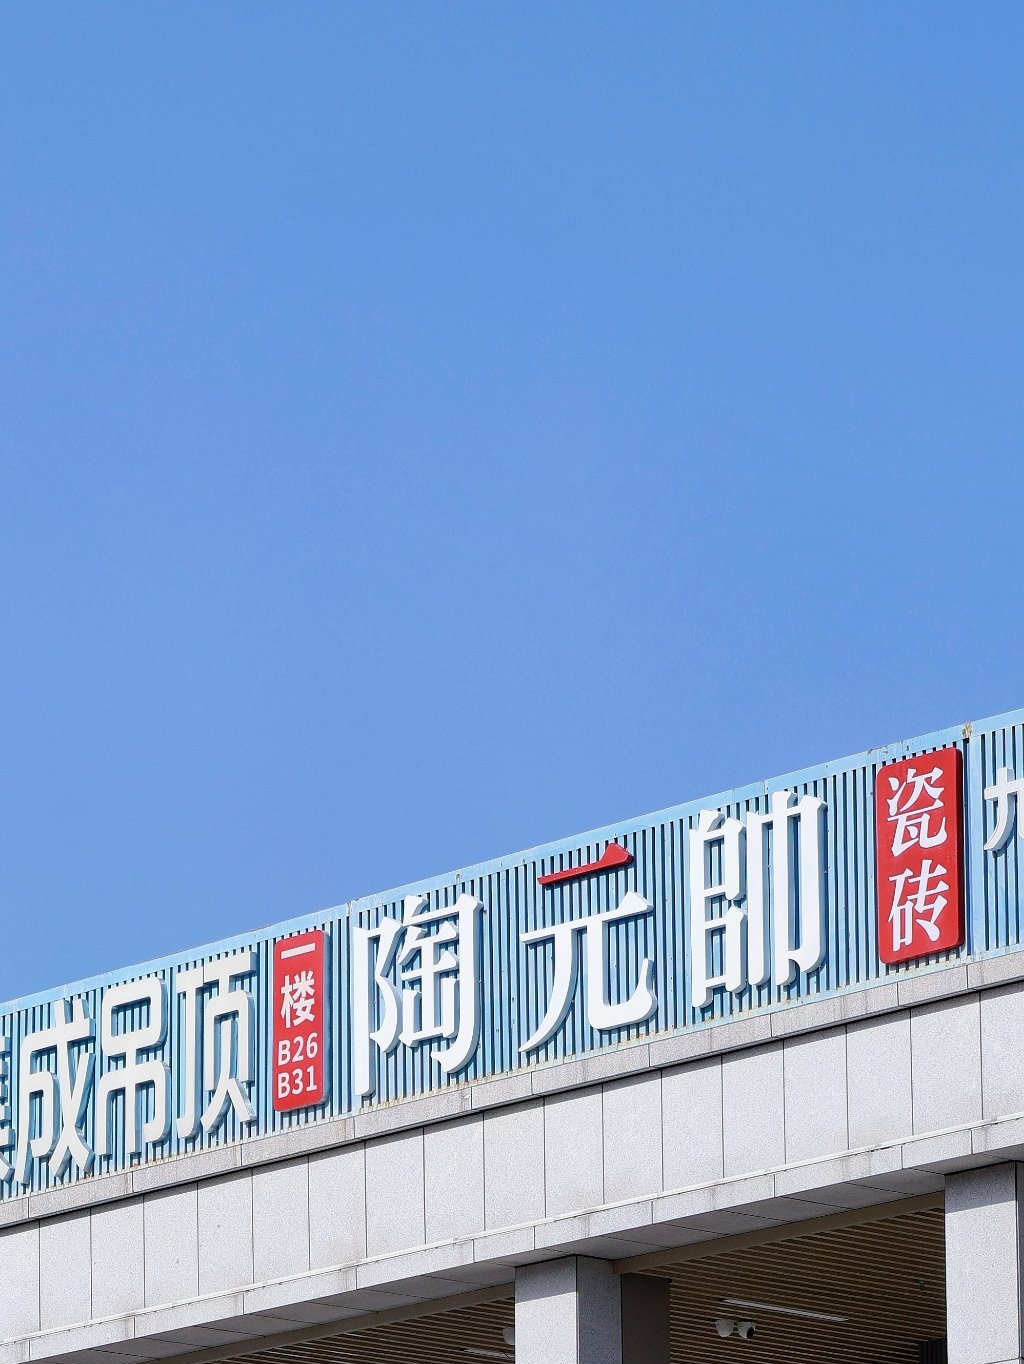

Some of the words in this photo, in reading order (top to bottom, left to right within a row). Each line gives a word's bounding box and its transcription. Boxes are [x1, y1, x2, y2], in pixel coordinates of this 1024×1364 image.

[885, 766, 951, 954] 瓷砖
[279, 938, 317, 1030] 一楼
[353, 792, 827, 1098] 陶元帥
[277, 1032, 319, 1066] B26
[277, 1065, 319, 1100] B31
